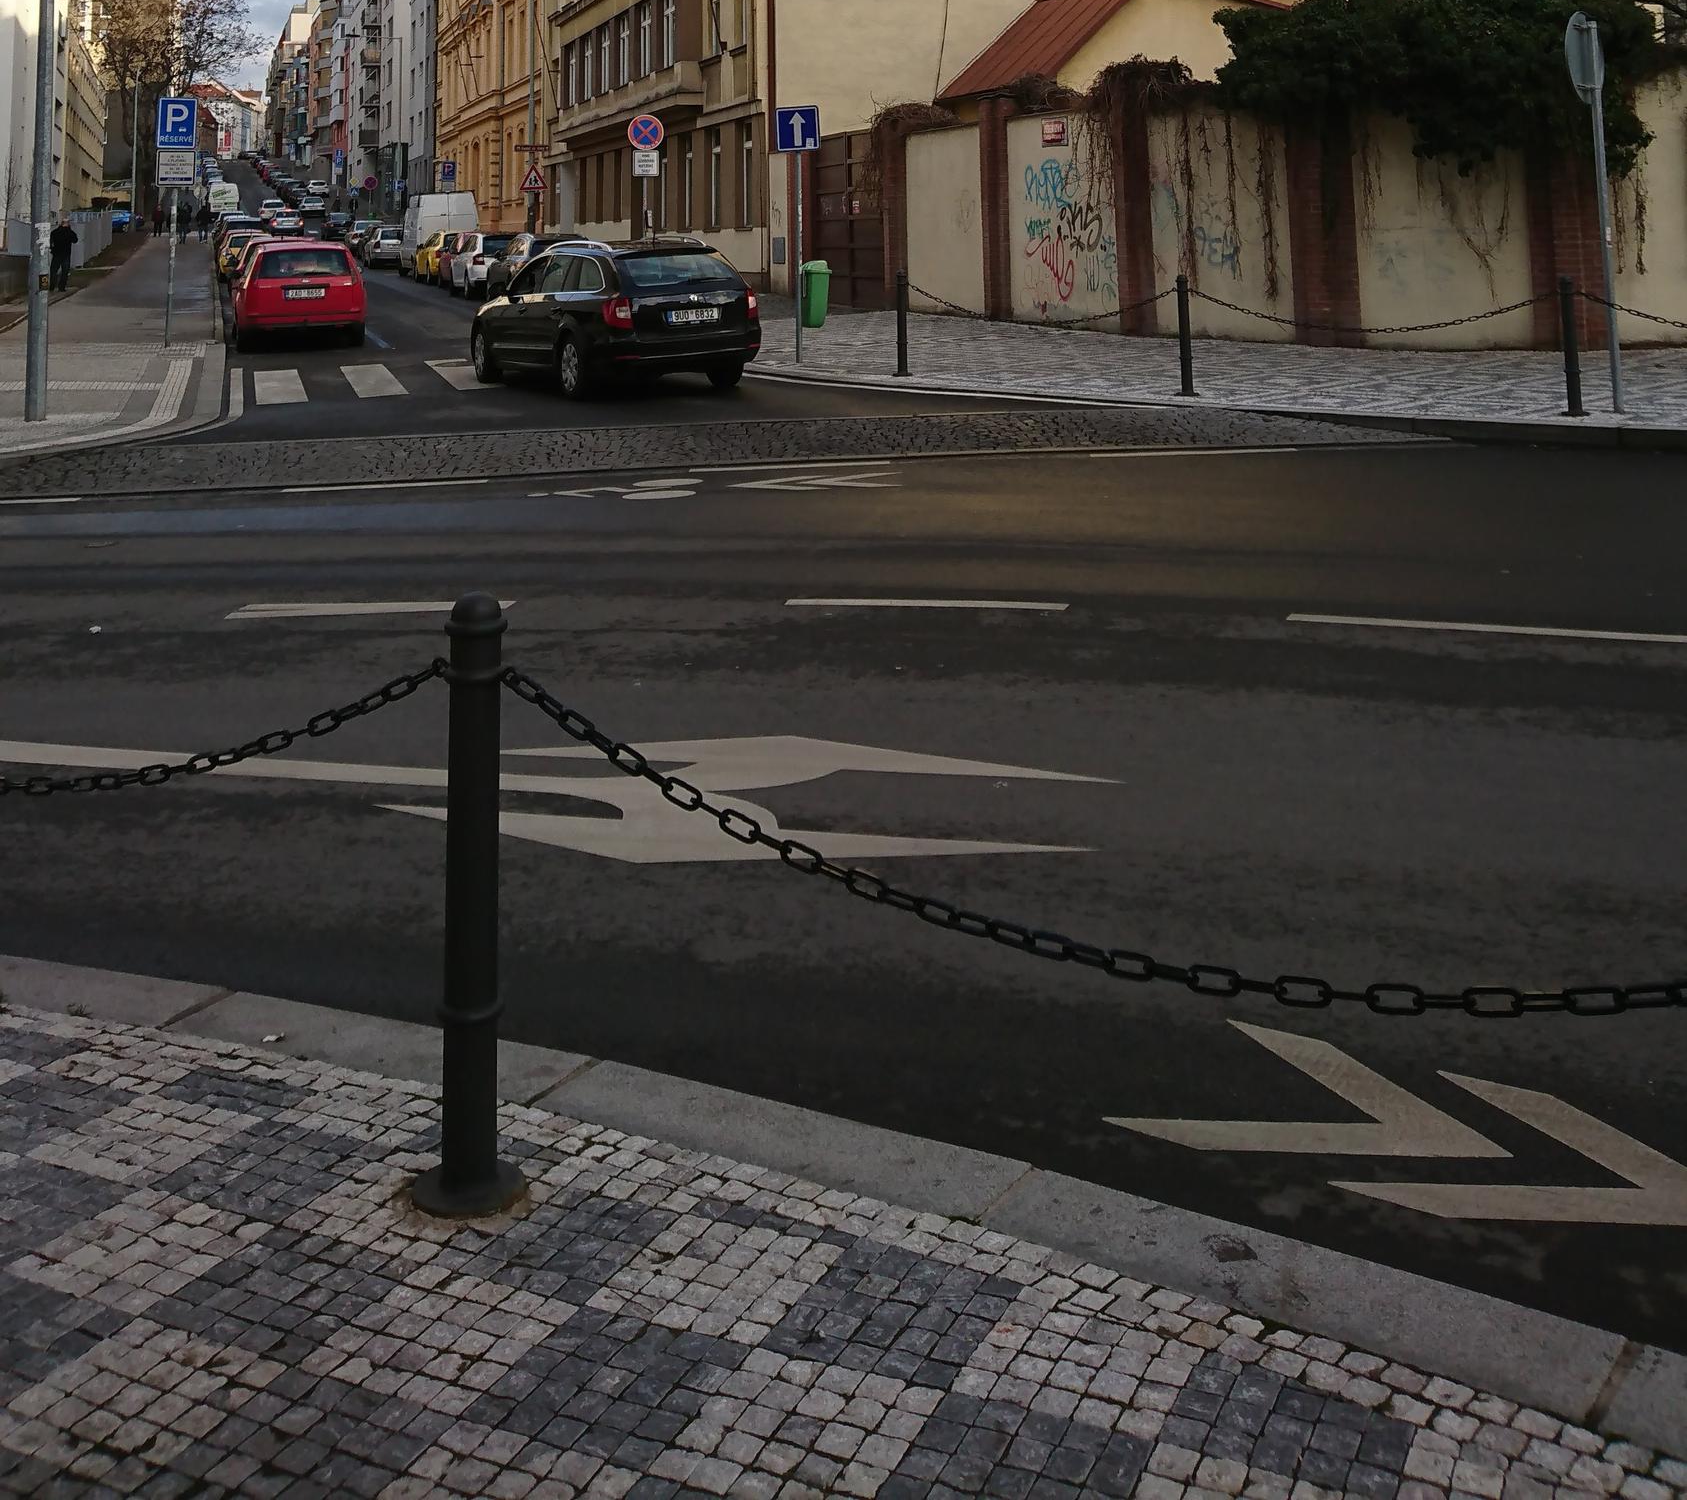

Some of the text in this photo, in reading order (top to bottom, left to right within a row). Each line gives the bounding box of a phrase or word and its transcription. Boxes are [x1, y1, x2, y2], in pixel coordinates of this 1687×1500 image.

[166, 104, 189, 132] P
[159, 135, 193, 143] RÉSERVÉ
[695, 309, 715, 319] 6832
